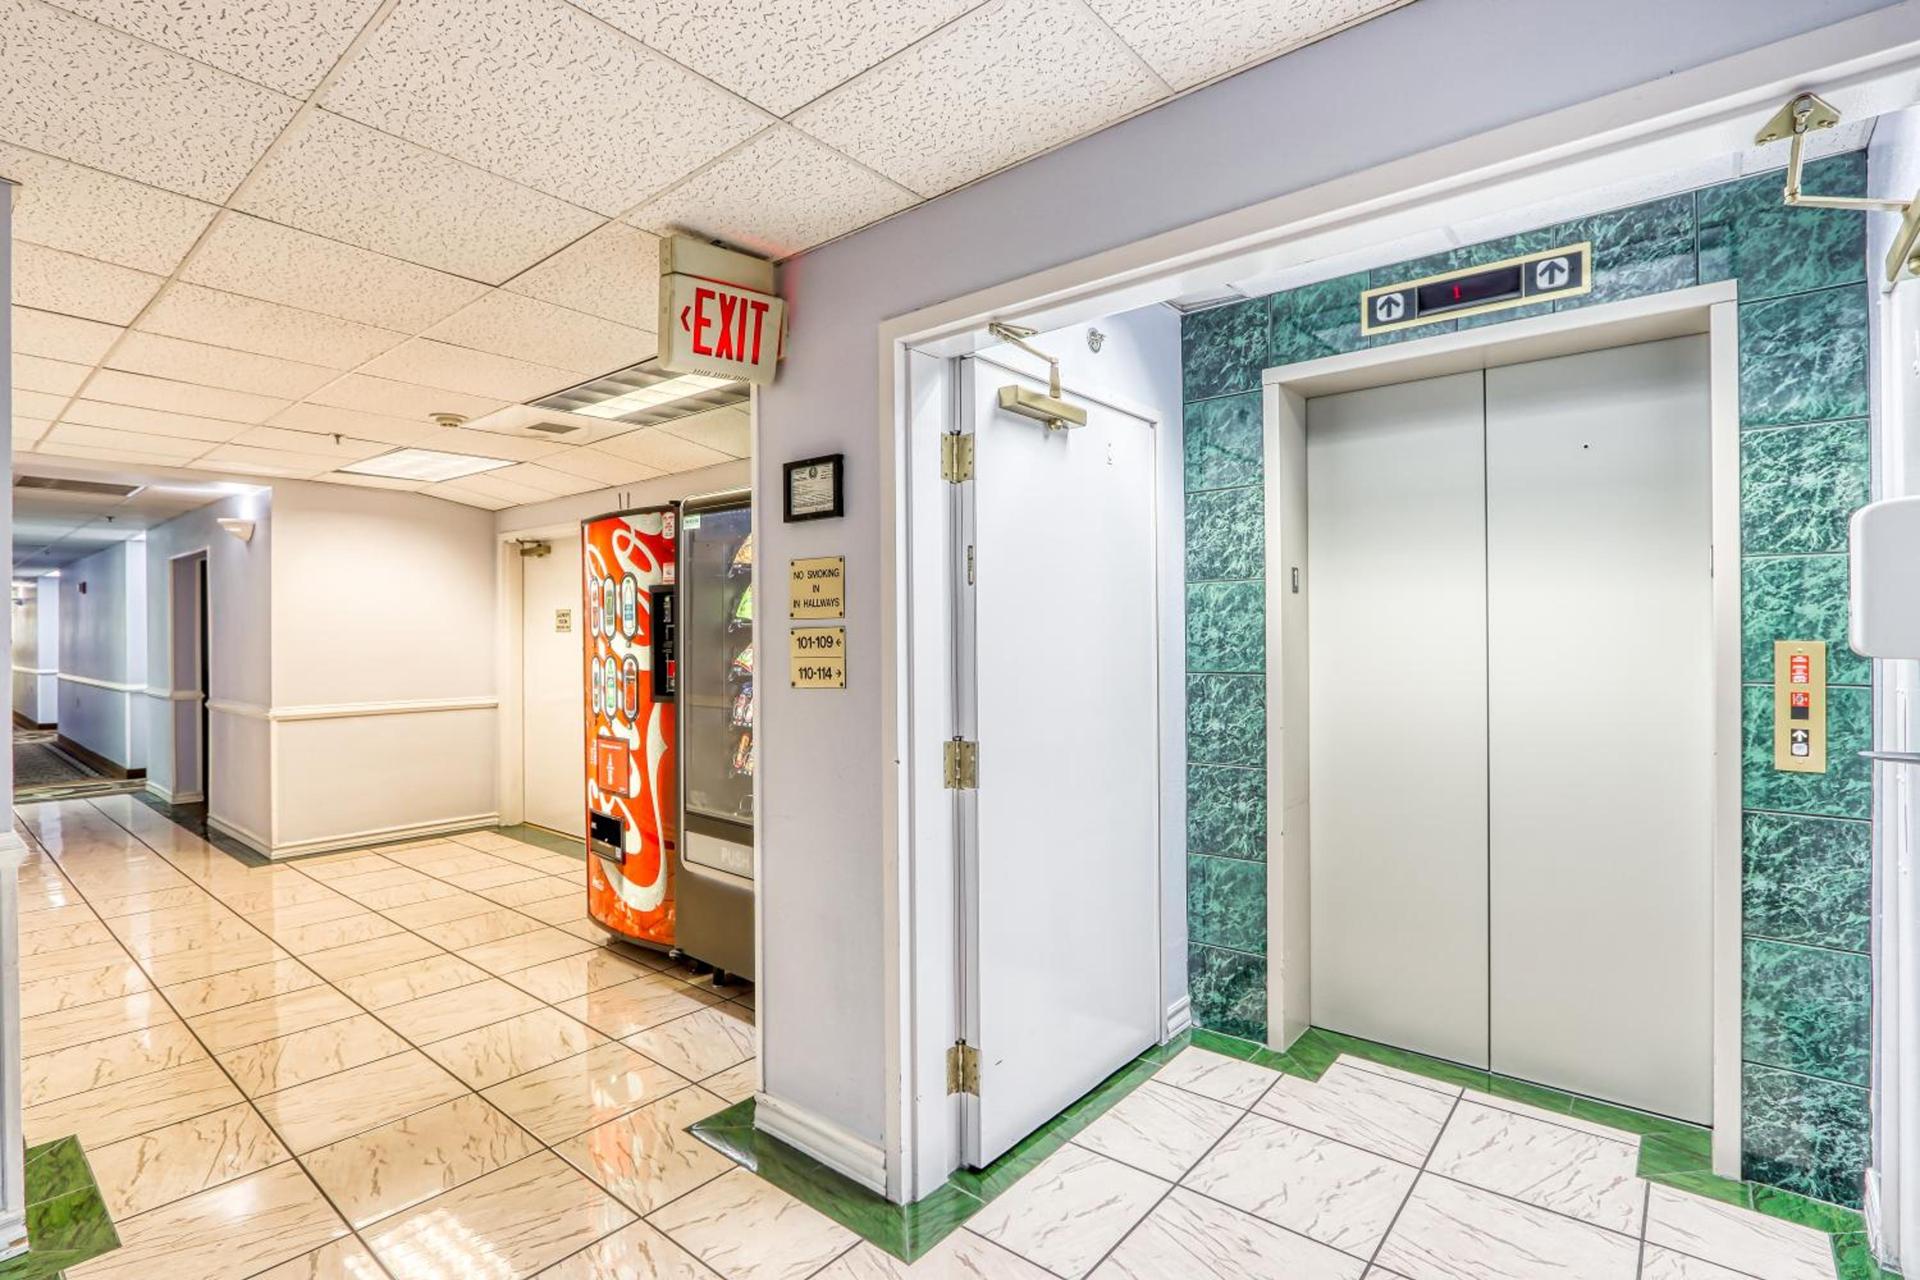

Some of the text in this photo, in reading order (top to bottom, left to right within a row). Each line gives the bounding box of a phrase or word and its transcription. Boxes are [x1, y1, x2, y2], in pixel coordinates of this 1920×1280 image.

[693, 287, 769, 365] EXIT
[793, 568, 840, 580] NO SMOKING
[812, 584, 820, 593] IN
[793, 597, 840, 608] IN HALLWAYS
[796, 635, 834, 649] 101-109
[798, 666, 832, 680] 110-114
